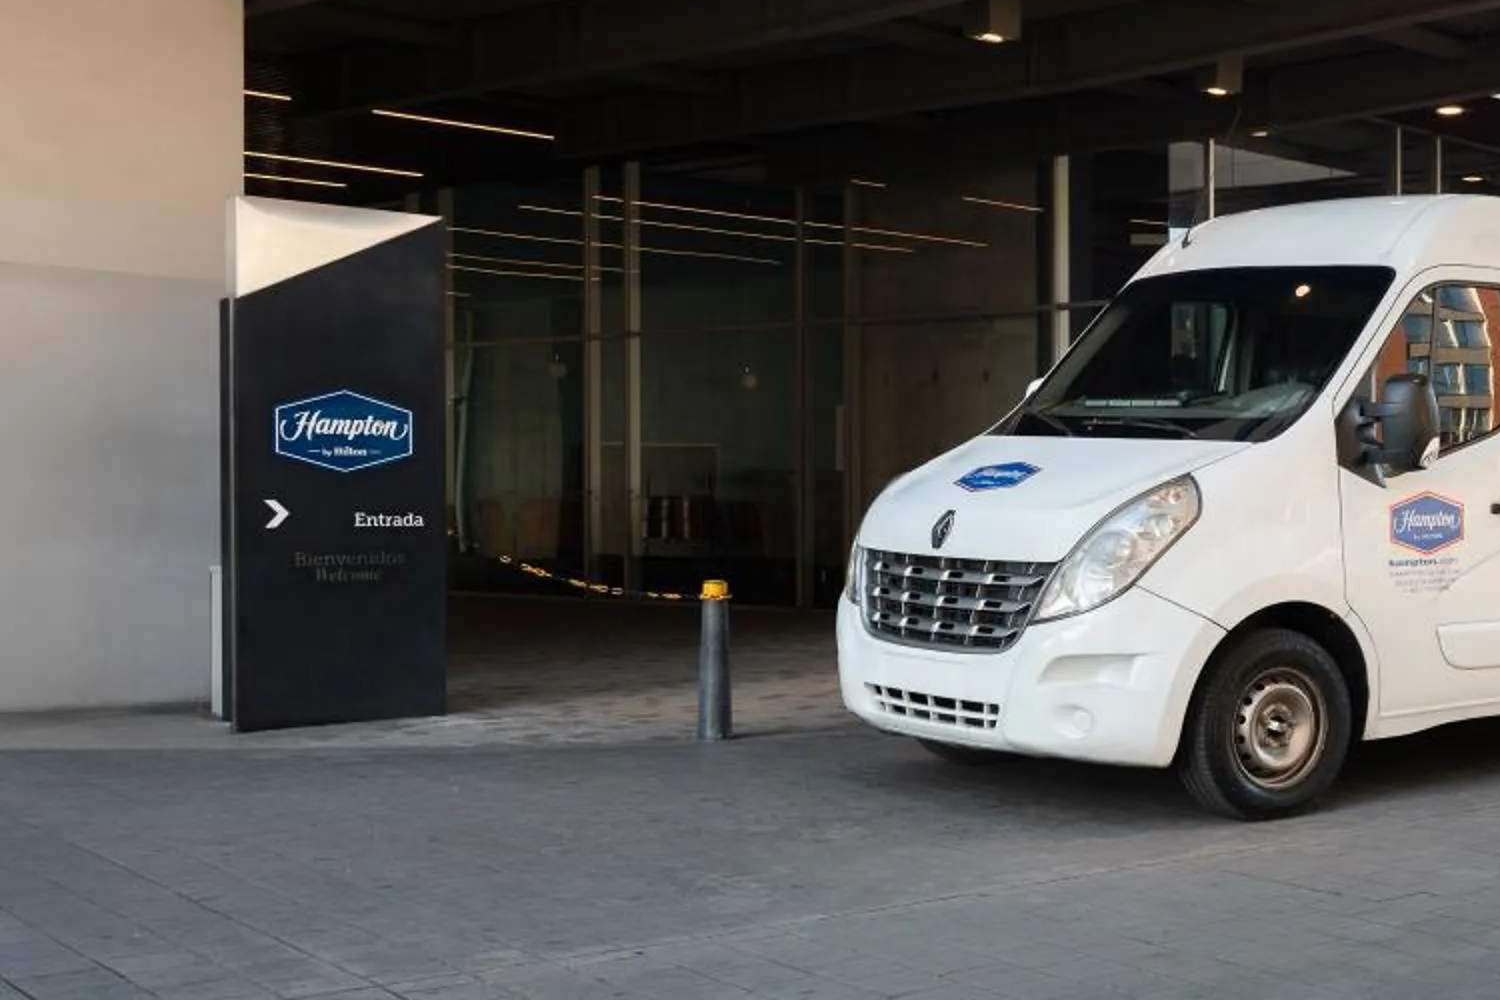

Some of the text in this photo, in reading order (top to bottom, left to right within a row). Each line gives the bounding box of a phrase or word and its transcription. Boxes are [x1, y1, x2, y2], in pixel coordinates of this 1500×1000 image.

[279, 409, 409, 442] Hampton
[333, 445, 367, 457] Hilton
[353, 511, 425, 527] Entrada
[1392, 509, 1461, 534] Hampton
